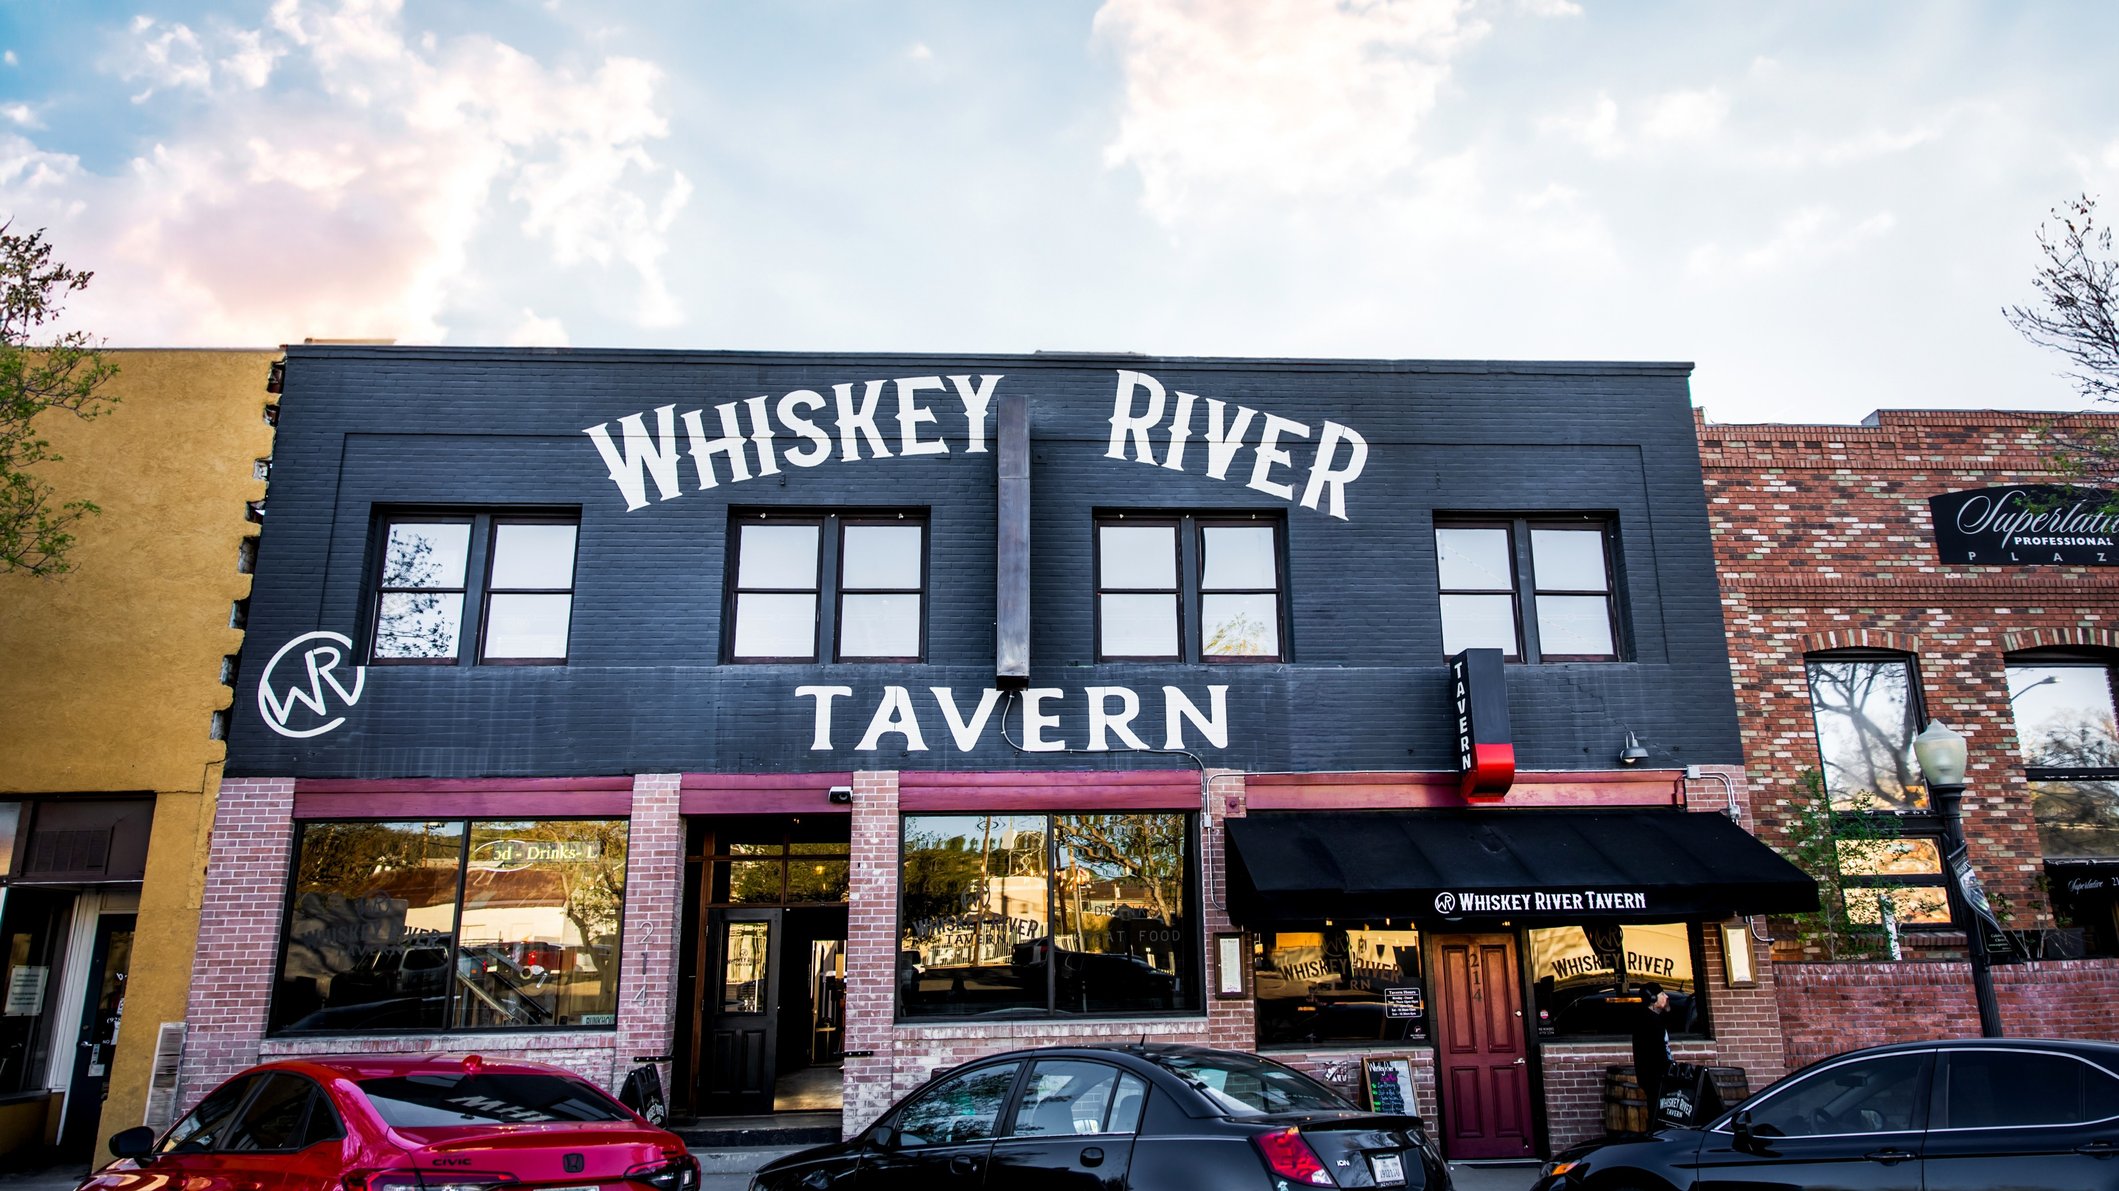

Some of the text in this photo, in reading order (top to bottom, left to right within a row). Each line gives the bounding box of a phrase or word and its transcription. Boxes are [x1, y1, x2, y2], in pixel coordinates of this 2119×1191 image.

[582, 369, 1368, 521] WHISKEY RIVER
[2014, 537, 2114, 546] PROFESSIONAL
[795, 685, 1229, 752] TAVERN
[1454, 662, 1471, 770] TAVERN
[1458, 893, 1531, 911] WHISKEY
[1534, 892, 1583, 910] RIVER
[1585, 891, 1647, 909] TAVERN
[1139, 930, 1181, 942] FOOD
[1279, 957, 1348, 981] WHISKEY
[1470, 953, 1483, 1001] 214
[1551, 953, 1621, 979] WHISKEY
[1628, 951, 1674, 978] RIVER
[432, 1158, 472, 1166] CIVIC
